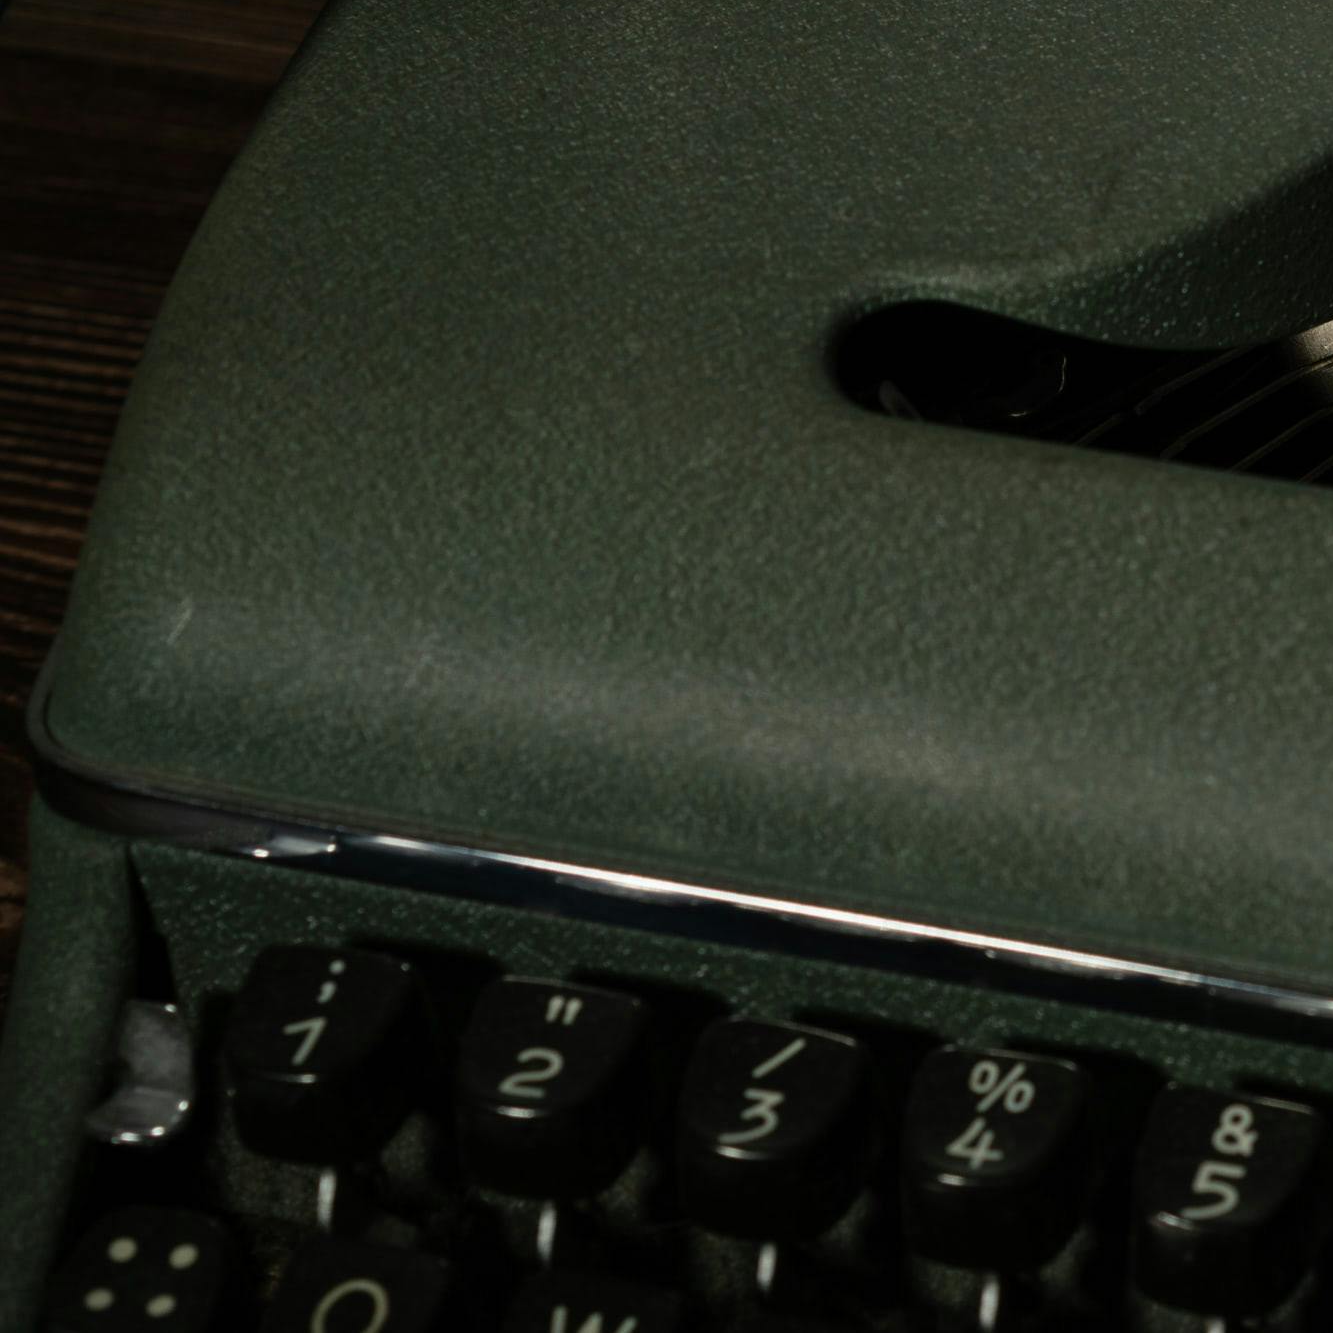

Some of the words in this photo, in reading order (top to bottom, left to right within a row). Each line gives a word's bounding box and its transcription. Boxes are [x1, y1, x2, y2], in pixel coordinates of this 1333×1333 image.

[495, 1044, 567, 1101] 2
[966, 1057, 1038, 1116] %
[715, 1085, 787, 1144] 3
[943, 1114, 1007, 1172] 4
[1208, 1100, 1262, 1160] &
[1177, 1157, 1249, 1224] 5
